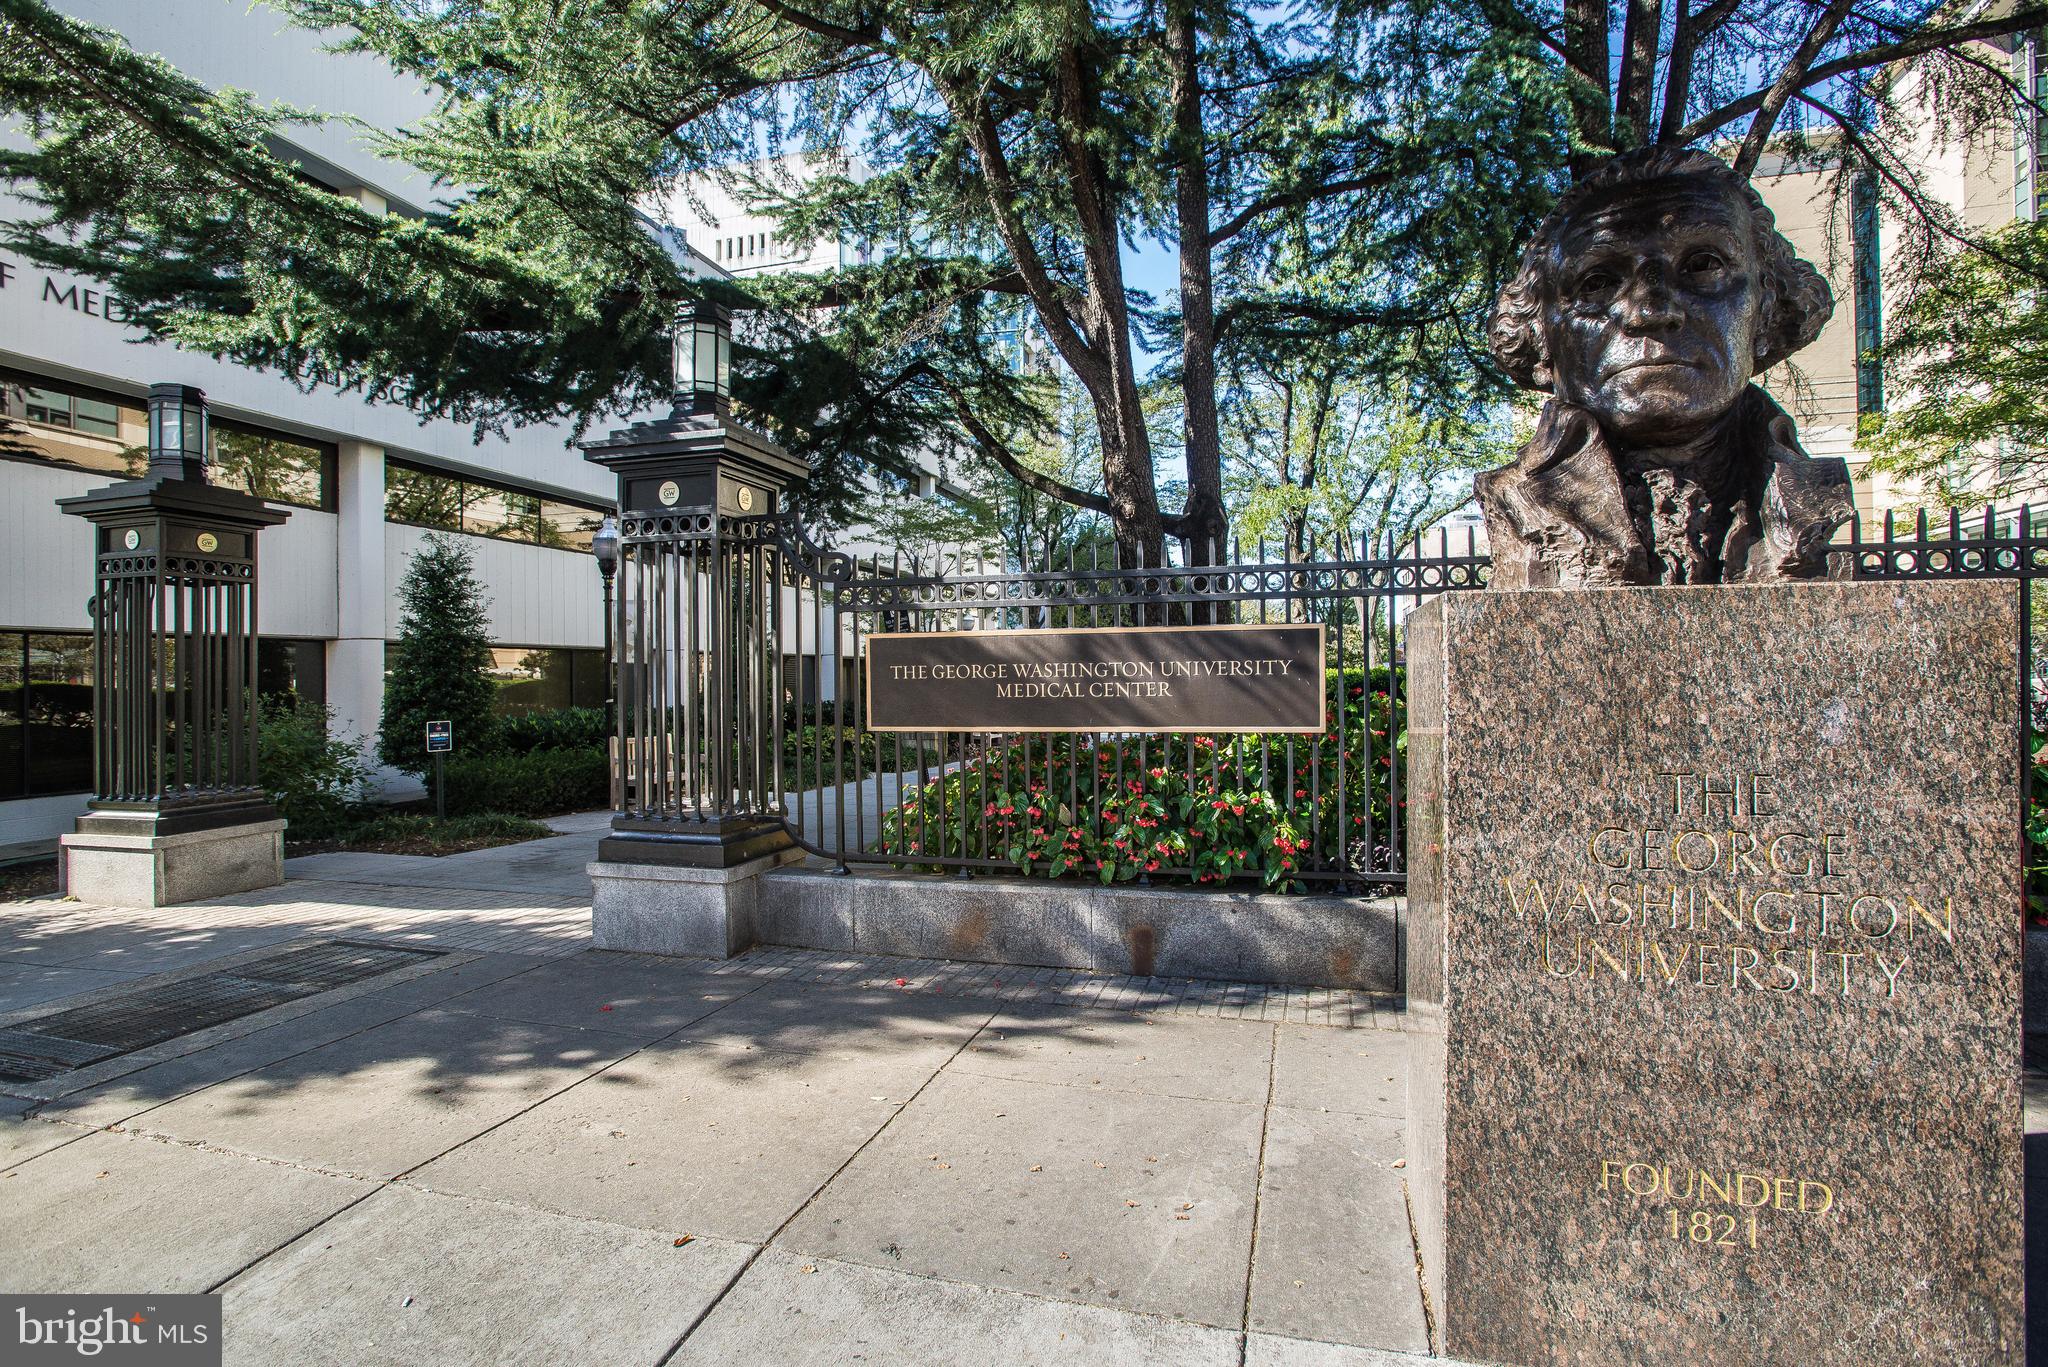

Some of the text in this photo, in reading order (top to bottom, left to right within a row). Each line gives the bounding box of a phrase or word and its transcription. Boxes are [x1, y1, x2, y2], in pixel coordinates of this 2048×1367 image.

[889, 660, 1293, 680] THE GEORGE WASHINGTON UNIVERSITY
[996, 681, 1173, 698] MEDICAL CENTER
[1657, 772, 1775, 817] THE
[1589, 827, 1850, 879] GEORGE
[1502, 876, 1955, 943] WASHINGTON
[1541, 933, 1911, 998] UNIVERSITY
[1601, 1159, 1834, 1214] FOUNDED
[1666, 1208, 1757, 1249] 1821
